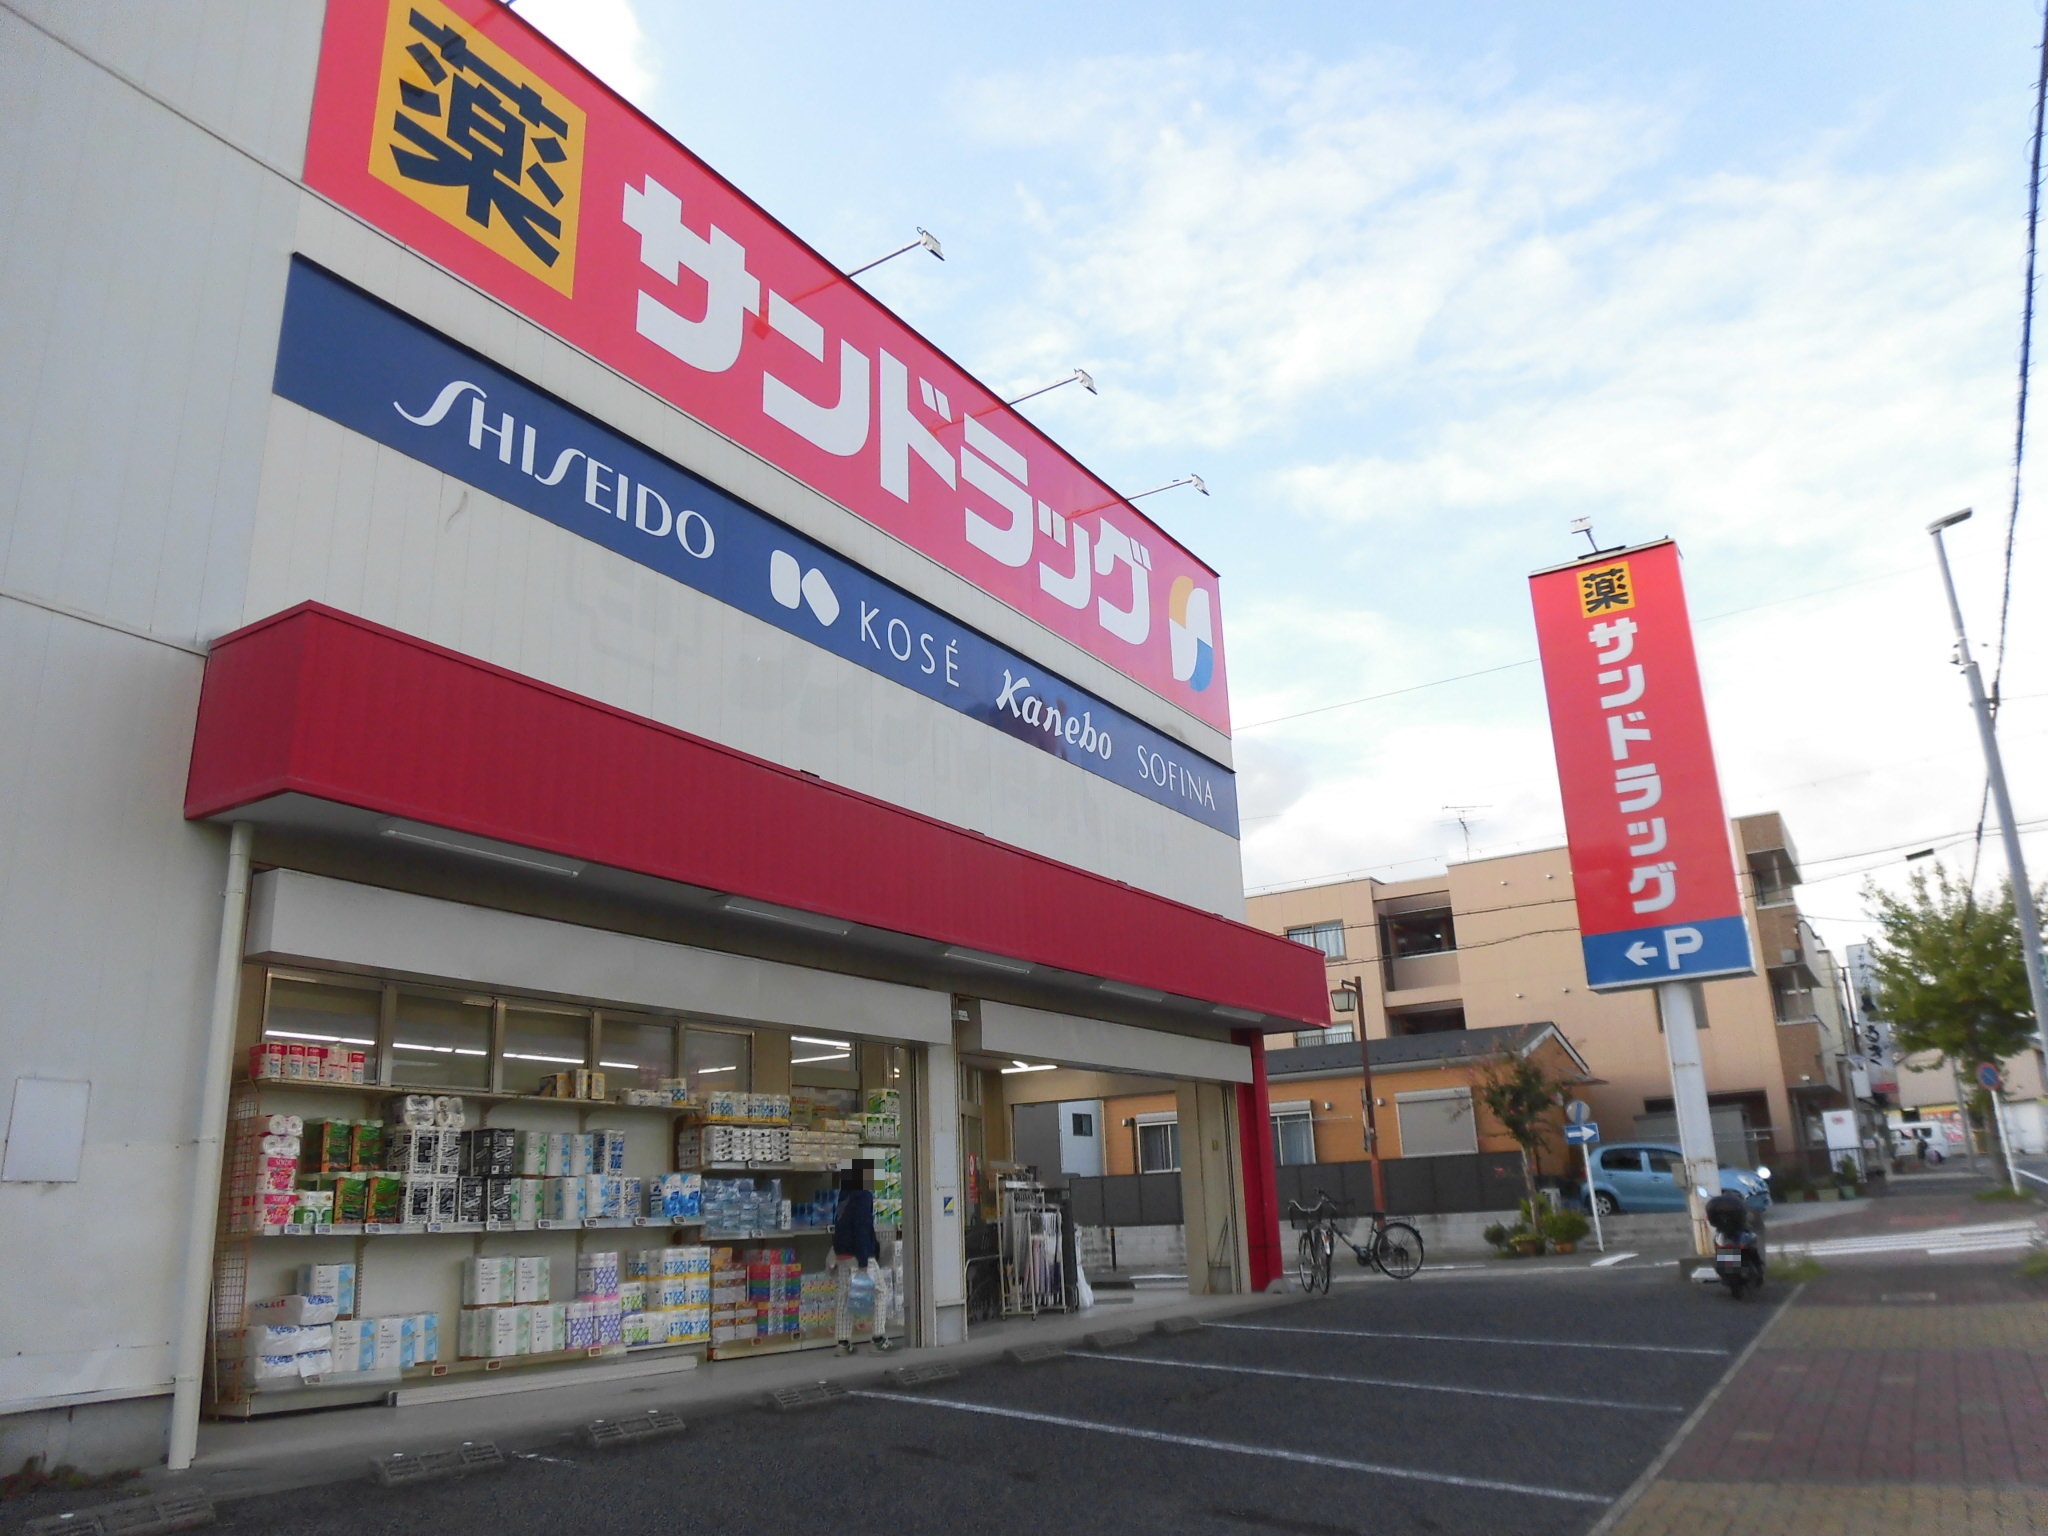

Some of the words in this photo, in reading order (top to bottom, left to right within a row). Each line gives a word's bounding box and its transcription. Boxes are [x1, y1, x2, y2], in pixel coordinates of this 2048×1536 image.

[389, 7, 569, 268] 薬
[622, 173, 1152, 646] サンドラッグ
[393, 380, 716, 560] SHISEIDO
[1584, 567, 1630, 614] 薬
[860, 600, 960, 688] KOSÉ
[996, 668, 1113, 761] Kanebo
[1137, 744, 1216, 811] SOFINA
[1588, 617, 1678, 914] サンドラッグ
[1667, 927, 1704, 970] P
